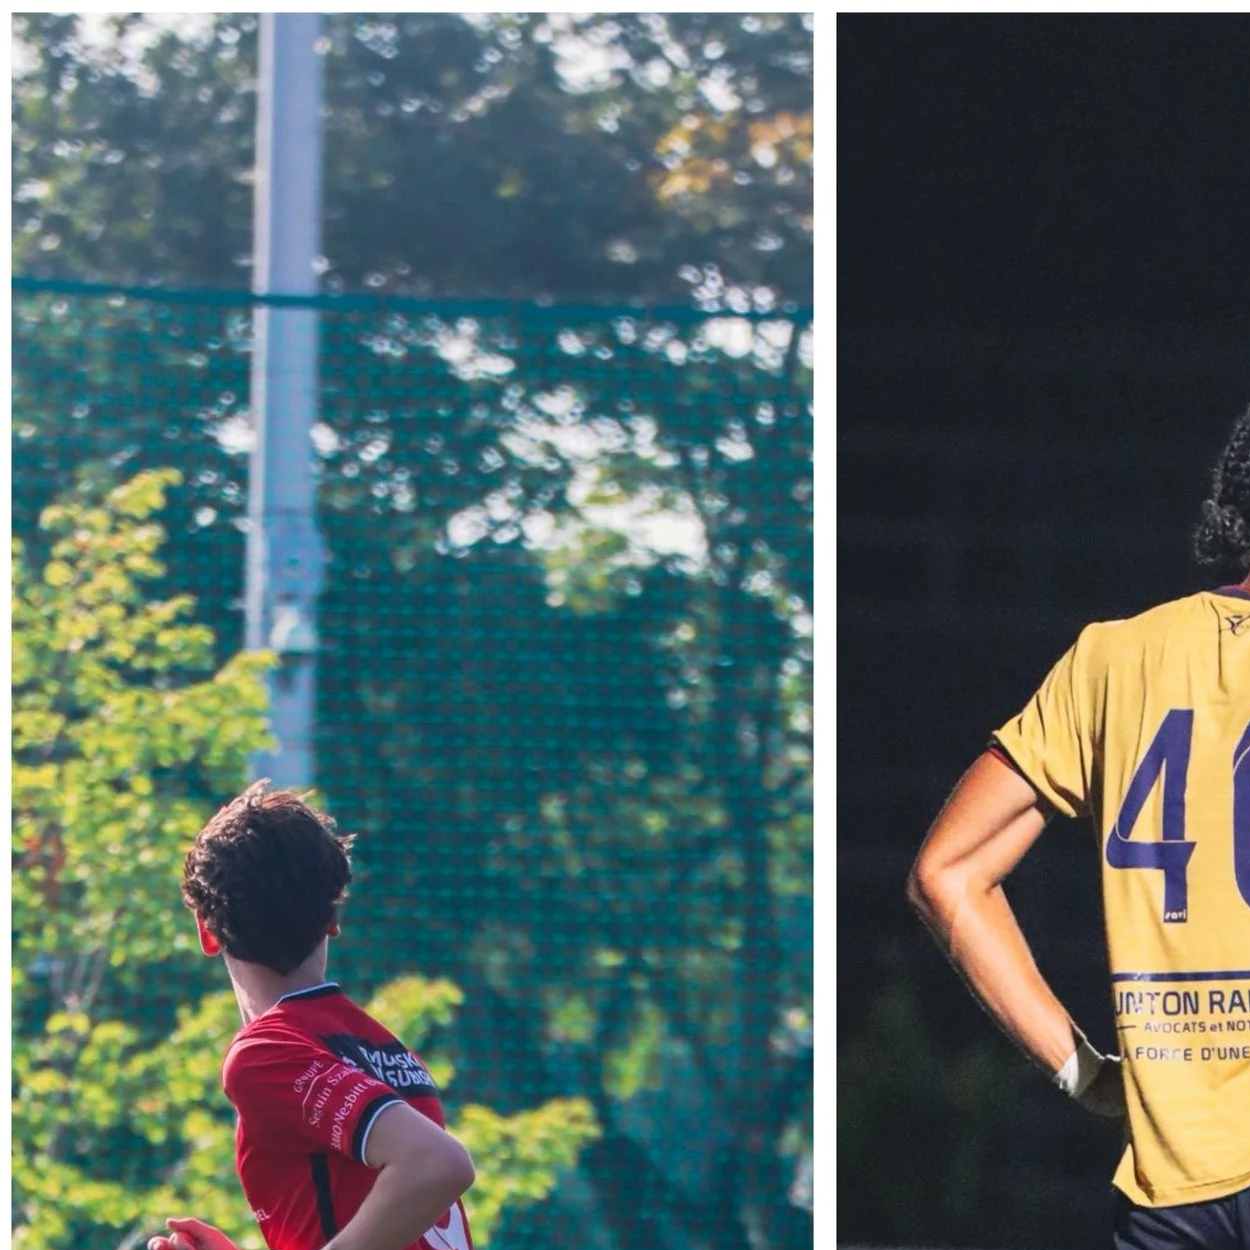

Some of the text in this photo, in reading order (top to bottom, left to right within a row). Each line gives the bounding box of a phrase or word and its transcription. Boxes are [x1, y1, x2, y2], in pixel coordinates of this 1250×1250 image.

[1144, 1022, 1206, 1034] AVOCATS
[1210, 1022, 1223, 1033] et
[1135, 1046, 1193, 1061] FORCE
[1201, 1046, 1250, 1061] D'UNE
[293, 1060, 324, 1094] GROUPE
[333, 1081, 369, 1125] Nesbitt
